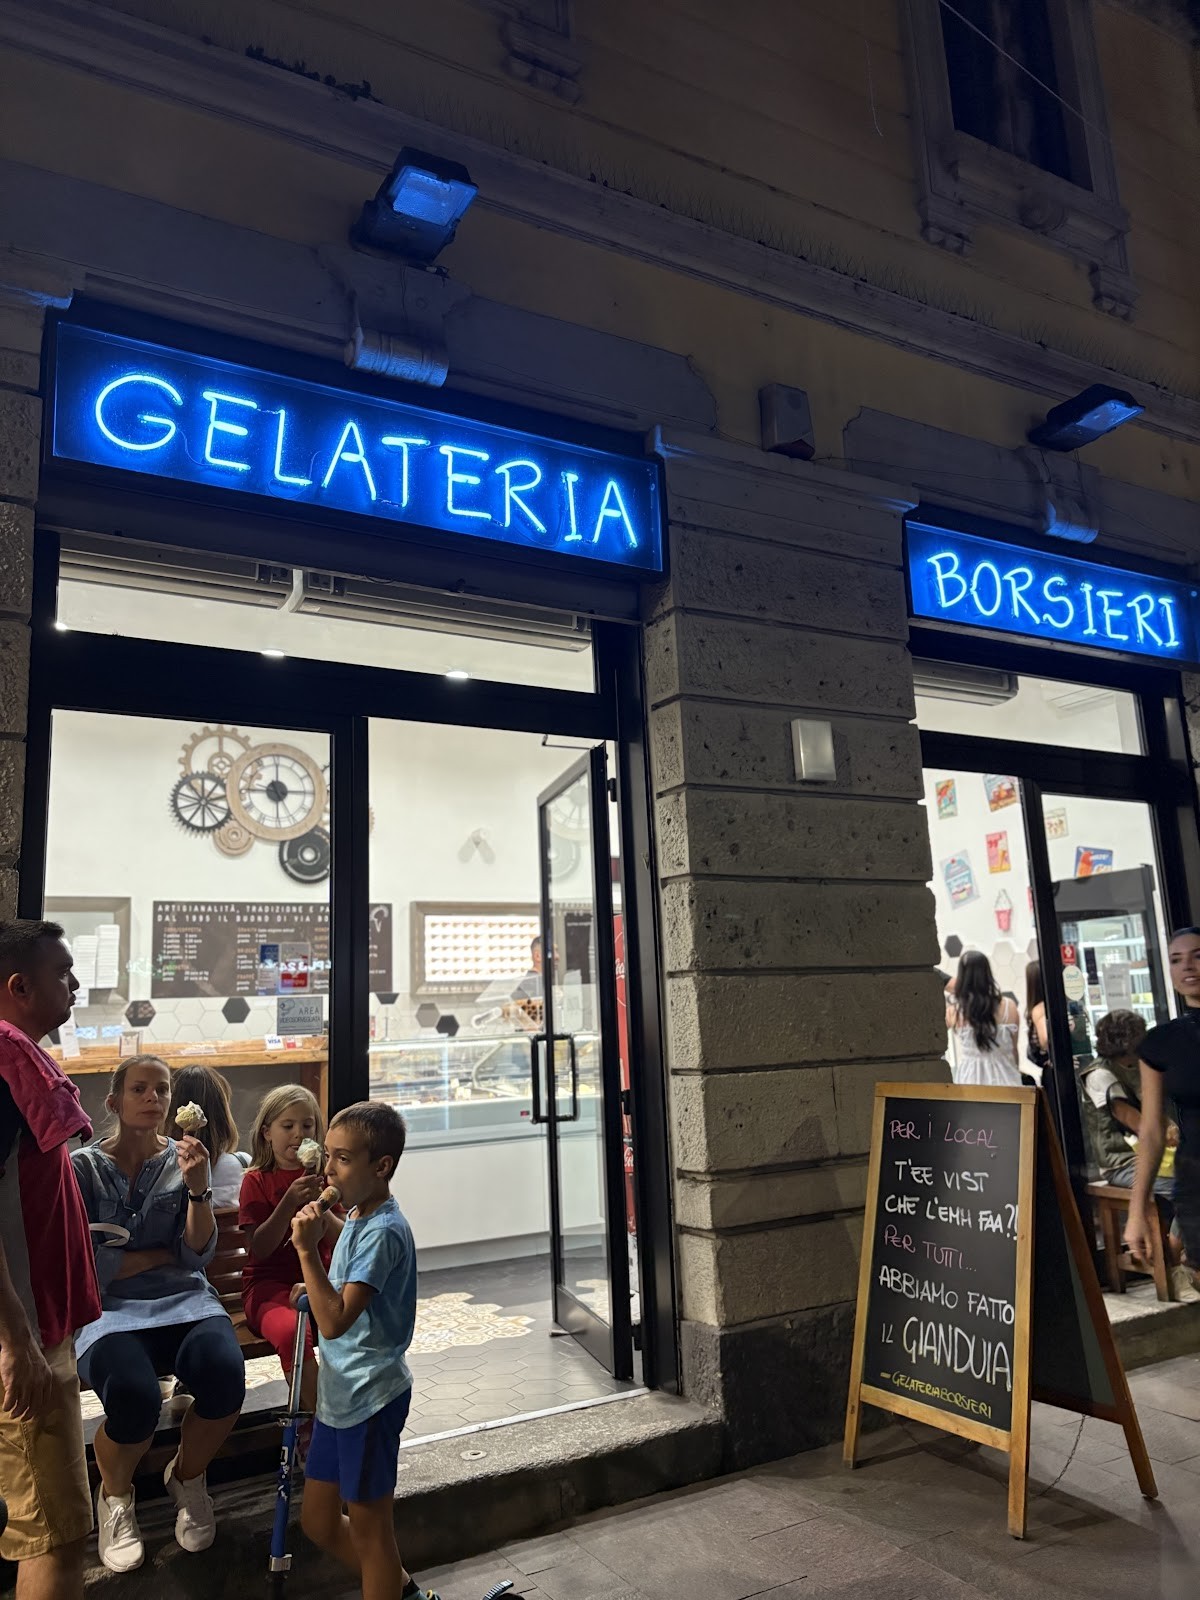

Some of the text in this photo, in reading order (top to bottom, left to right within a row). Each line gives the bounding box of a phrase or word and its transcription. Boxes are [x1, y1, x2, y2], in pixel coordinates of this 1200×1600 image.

[94, 372, 640, 549] GELATERIA
[927, 551, 1180, 647] BORSIERI
[157, 914, 177, 922] DAL
[236, 915, 270, 923] BUONO
[277, 915, 287, 923] DI
[294, 915, 311, 923] VIA
[246, 904, 304, 913] TRADIZIONE
[309, 905, 314, 913] E
[319, 905, 330, 913] PA
[298, 1006, 320, 1015] AREA
[889, 1119, 921, 1140] PER
[894, 1158, 989, 1193] T'EE VIST
[884, 1194, 920, 1216] CHE
[884, 1224, 916, 1254] PER
[878, 1265, 1015, 1325] ABBIAMO FATTO
[881, 1316, 1013, 1392] IL GIANDUIA
